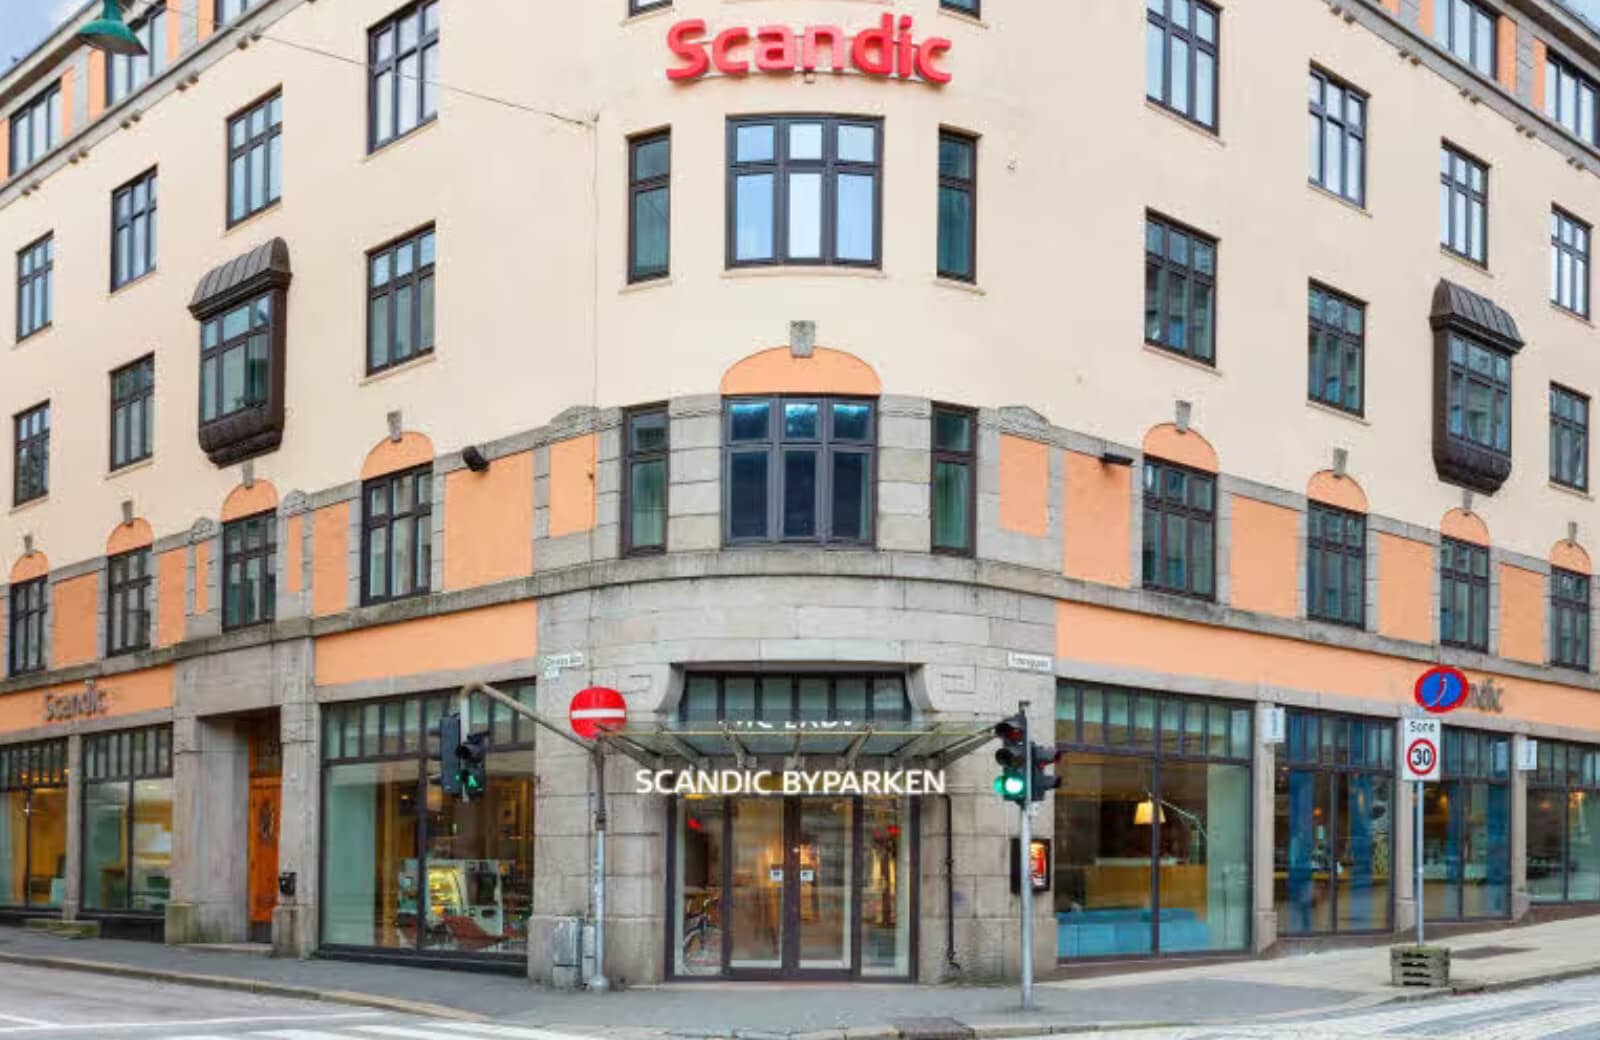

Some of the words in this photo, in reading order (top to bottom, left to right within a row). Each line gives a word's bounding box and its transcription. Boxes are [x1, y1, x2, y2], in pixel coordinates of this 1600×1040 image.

[666, 12, 951, 83] Scandic
[1412, 748, 1432, 766] 30
[635, 769, 772, 794] SCANDIC
[782, 769, 945, 794] BYPARKEN
